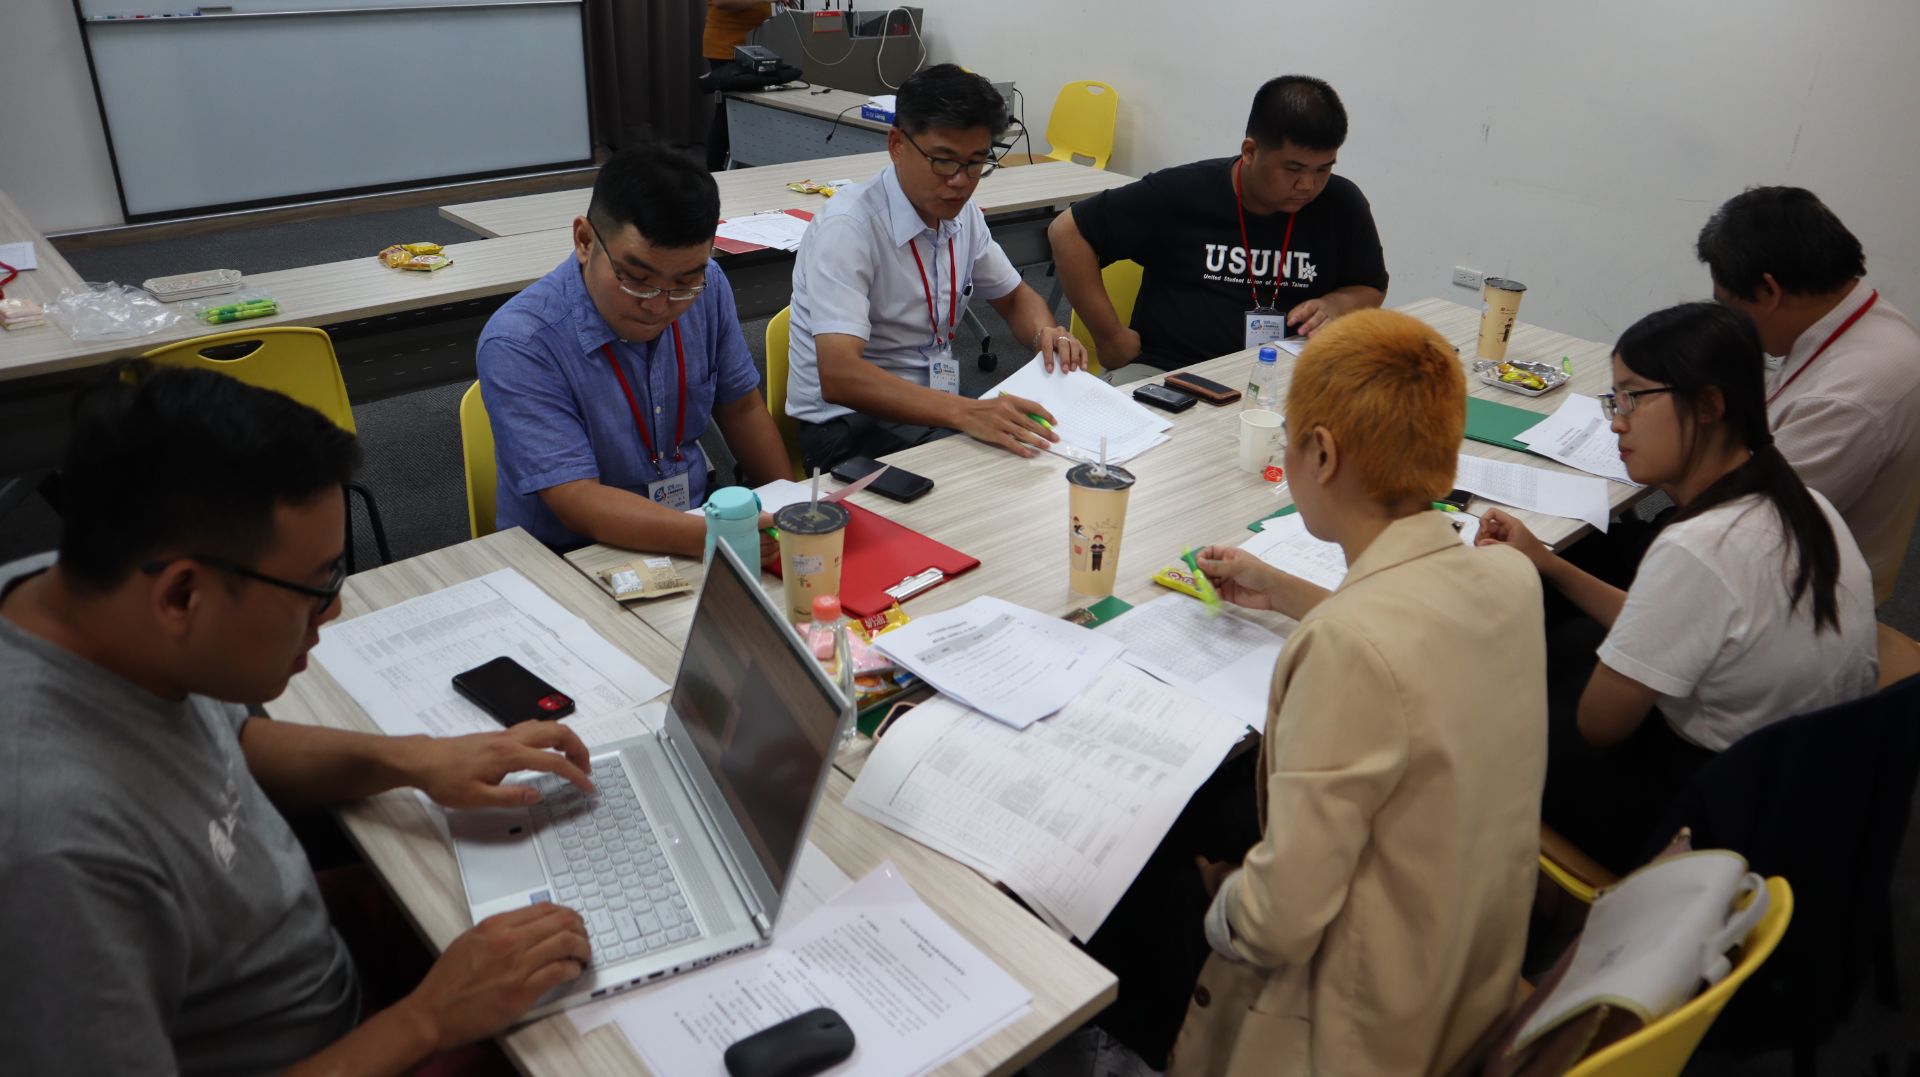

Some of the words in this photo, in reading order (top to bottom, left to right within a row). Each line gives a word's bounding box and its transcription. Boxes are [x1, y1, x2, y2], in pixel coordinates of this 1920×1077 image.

[1205, 243, 1310, 280] USUNT
[1203, 273, 1221, 281] United
[1223, 275, 1245, 284] Student
